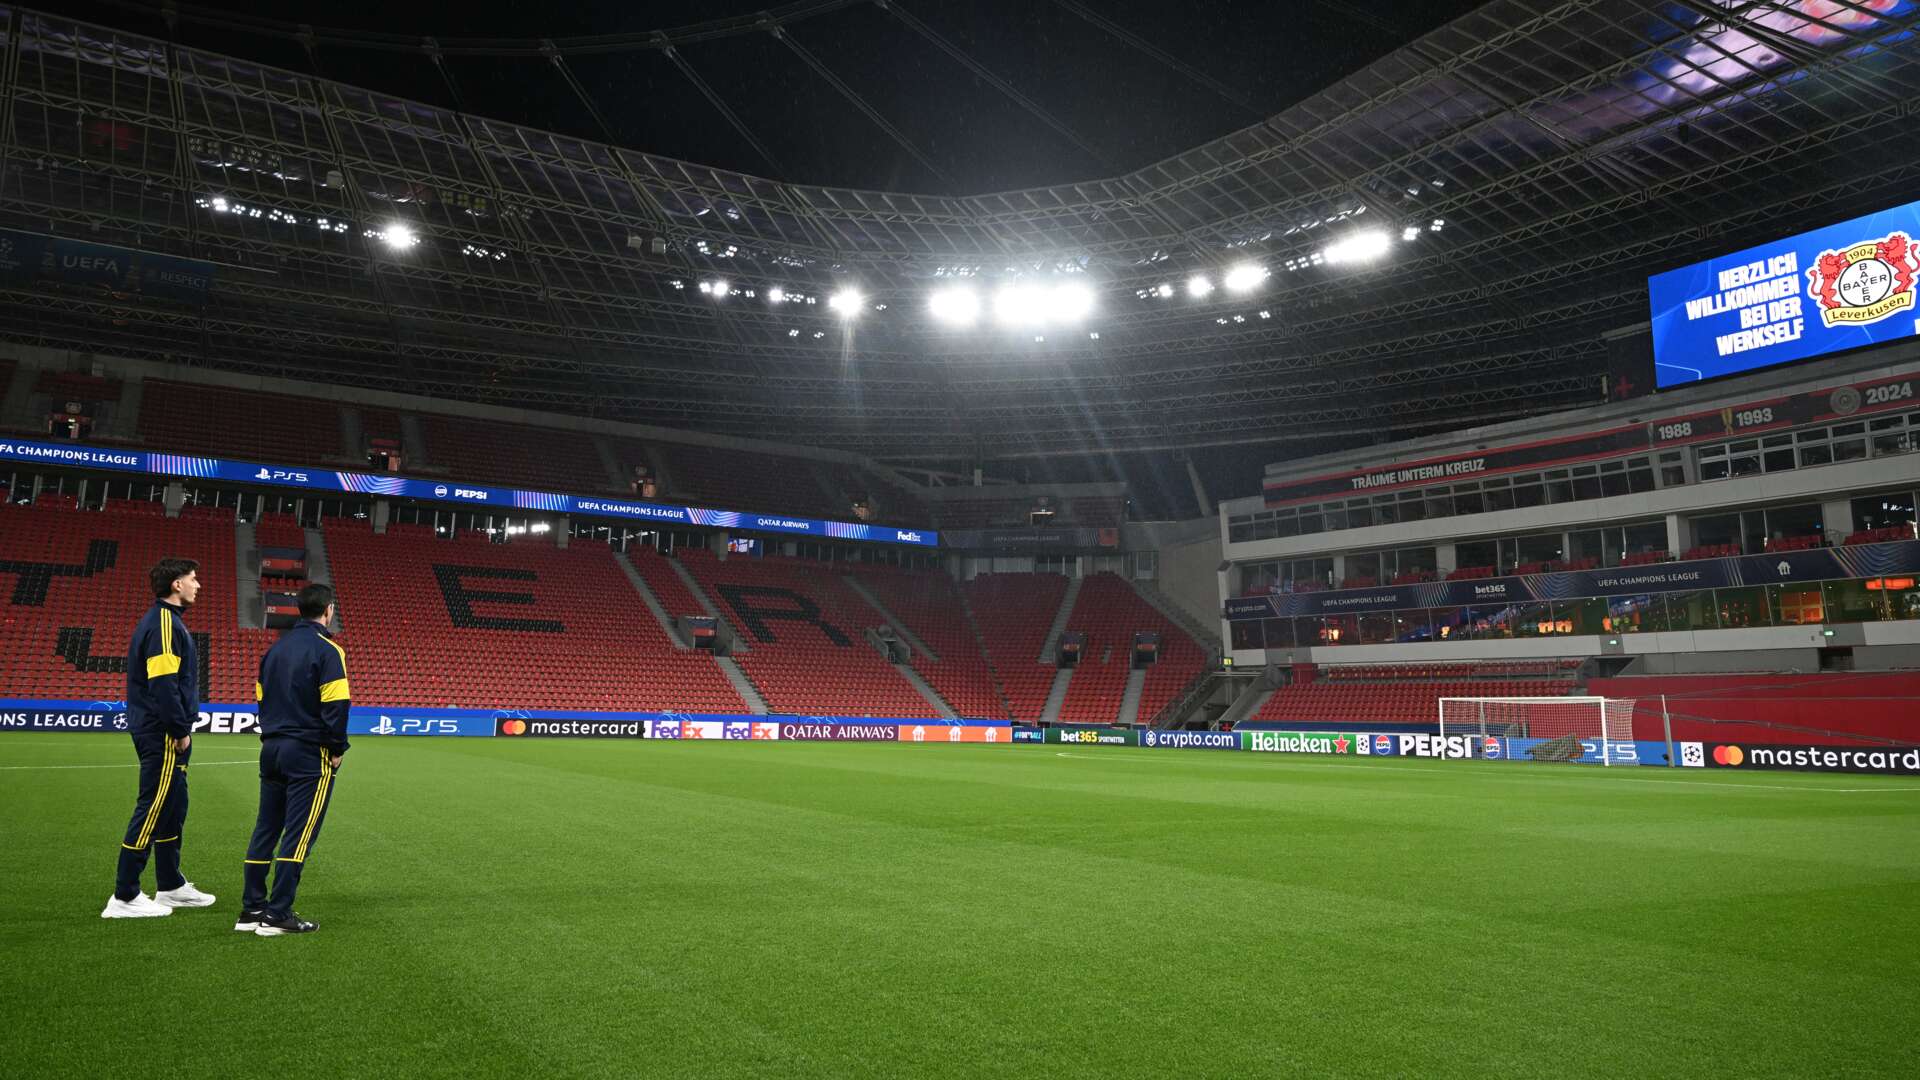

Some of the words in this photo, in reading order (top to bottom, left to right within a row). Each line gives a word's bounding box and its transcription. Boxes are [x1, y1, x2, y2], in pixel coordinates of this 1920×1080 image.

[1849, 248, 1873, 260] 1904
[63, 255, 119, 273] UEFA
[1718, 251, 1798, 291] HERZLICH
[160, 271, 208, 288] RESPECT
[1843, 274, 1887, 291] BAYER
[1859, 263, 1871, 303] BAYER
[1685, 274, 1800, 320] WILLKOMMEN
[1740, 306, 1767, 329] BEI
[1768, 297, 1802, 322] DER
[1832, 297, 1904, 319] Leverkusen
[1716, 318, 1804, 357] WERKSELF
[1865, 382, 1913, 405] 2024
[1736, 407, 1773, 427] 1993
[1658, 422, 1692, 440] 1988
[17, 446, 90, 460] CHAMPIONS
[92, 453, 138, 465] LEAGUE
[273, 471, 308, 481] PS5
[1352, 474, 1398, 489] TRÄUME
[1398, 465, 1445, 483] UNTERM
[1445, 459, 1486, 476] KREUZ
[455, 489, 487, 500] PEPSI
[578, 502, 600, 511] UEFA
[601, 504, 651, 516] CHAMPIONS
[652, 509, 684, 518] LEAGUE
[757, 518, 780, 527] QATAR
[781, 520, 809, 530] AIRWAYS
[1598, 579, 1619, 587] UEFA
[1619, 574, 1666, 585] CHAMPIONS
[1668, 571, 1700, 581] LEAGUE
[1475, 584, 1506, 594] bet365
[1322, 599, 1338, 607] UEFA
[1338, 597, 1373, 606] CHAMPIONS
[1374, 595, 1397, 603] LEAGUE
[34, 714, 104, 727] LEAGUE
[401, 719, 459, 733] PS5
[531, 720, 638, 736] mastercard
[651, 720, 704, 739] FedEx
[723, 722, 773, 740] FedEx
[783, 724, 834, 740] QATAR
[838, 725, 894, 740] AIRWAYS
[1060, 730, 1097, 742] bet365
[1160, 732, 1234, 748] crypto.com
[1251, 733, 1332, 753] Heineken
[1399, 735, 1472, 758] PEPSI
[1752, 747, 1920, 770] mastercard
